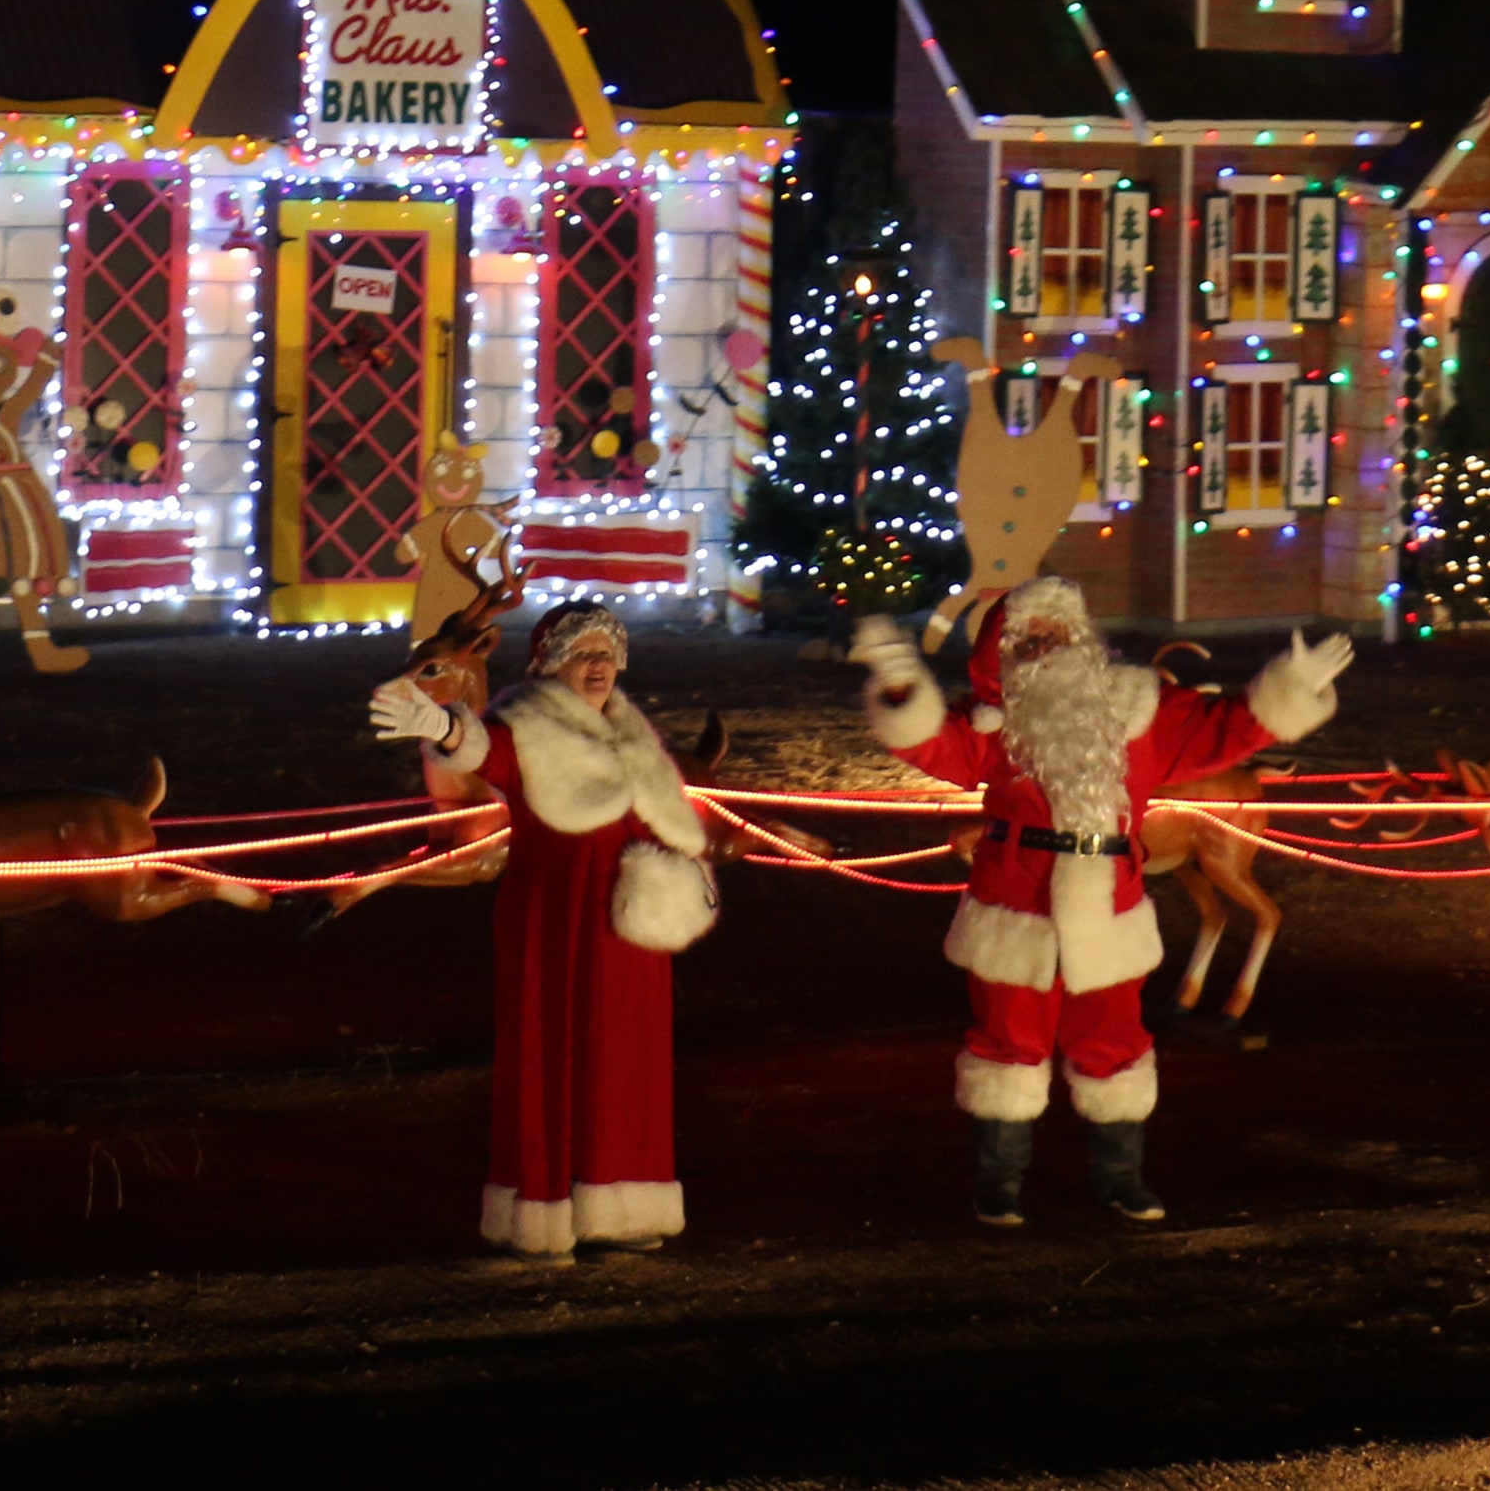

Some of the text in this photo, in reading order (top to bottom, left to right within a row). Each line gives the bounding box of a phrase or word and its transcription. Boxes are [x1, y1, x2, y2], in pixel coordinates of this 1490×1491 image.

[330, 14, 463, 66] Claus
[321, 79, 471, 125] BAKERY
[338, 276, 393, 299] OPEN
